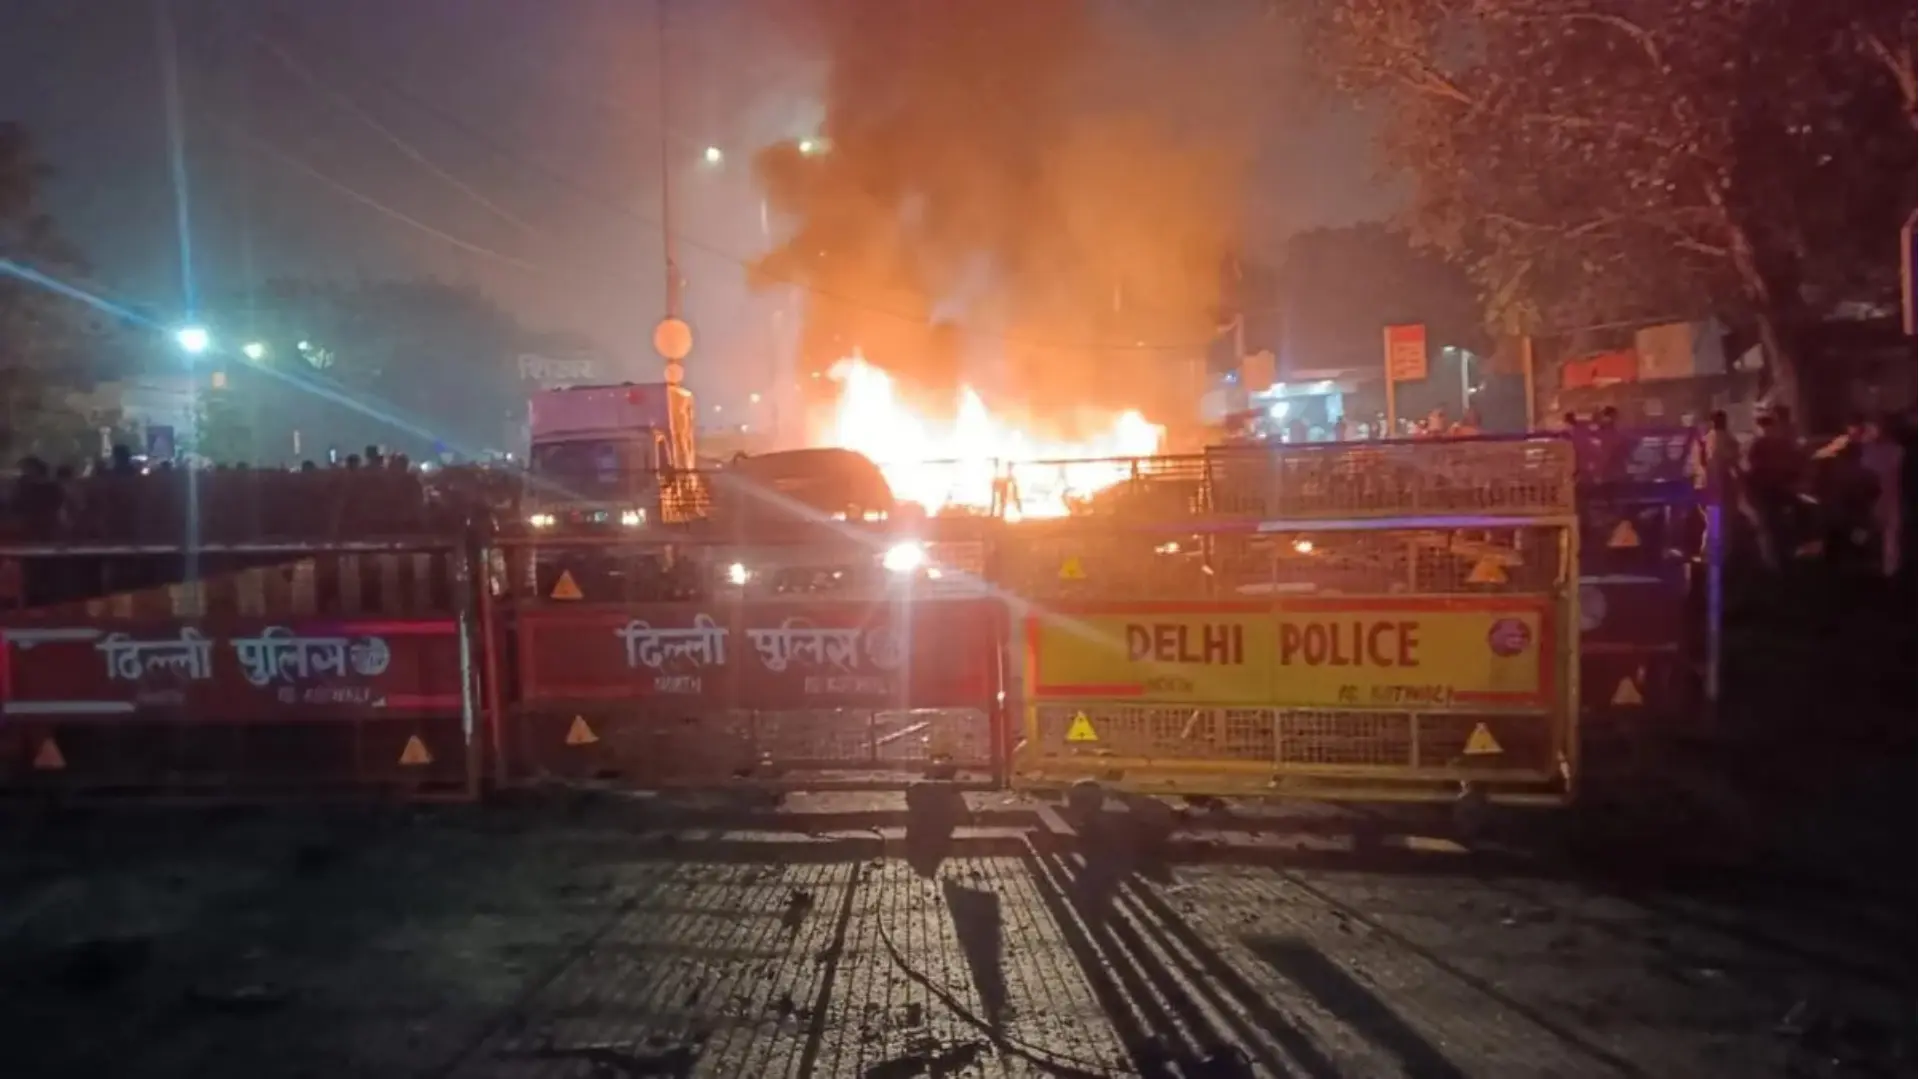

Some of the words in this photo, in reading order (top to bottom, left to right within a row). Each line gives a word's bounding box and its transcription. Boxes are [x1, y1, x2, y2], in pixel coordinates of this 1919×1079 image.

[96, 627, 213, 680] दिल्ली
[230, 626, 348, 686] पुलिस
[616, 614, 728, 671] दिल्ली
[747, 617, 861, 672] पुलिस
[1126, 623, 1244, 666] DELHI
[1279, 621, 1420, 667] POLICE
